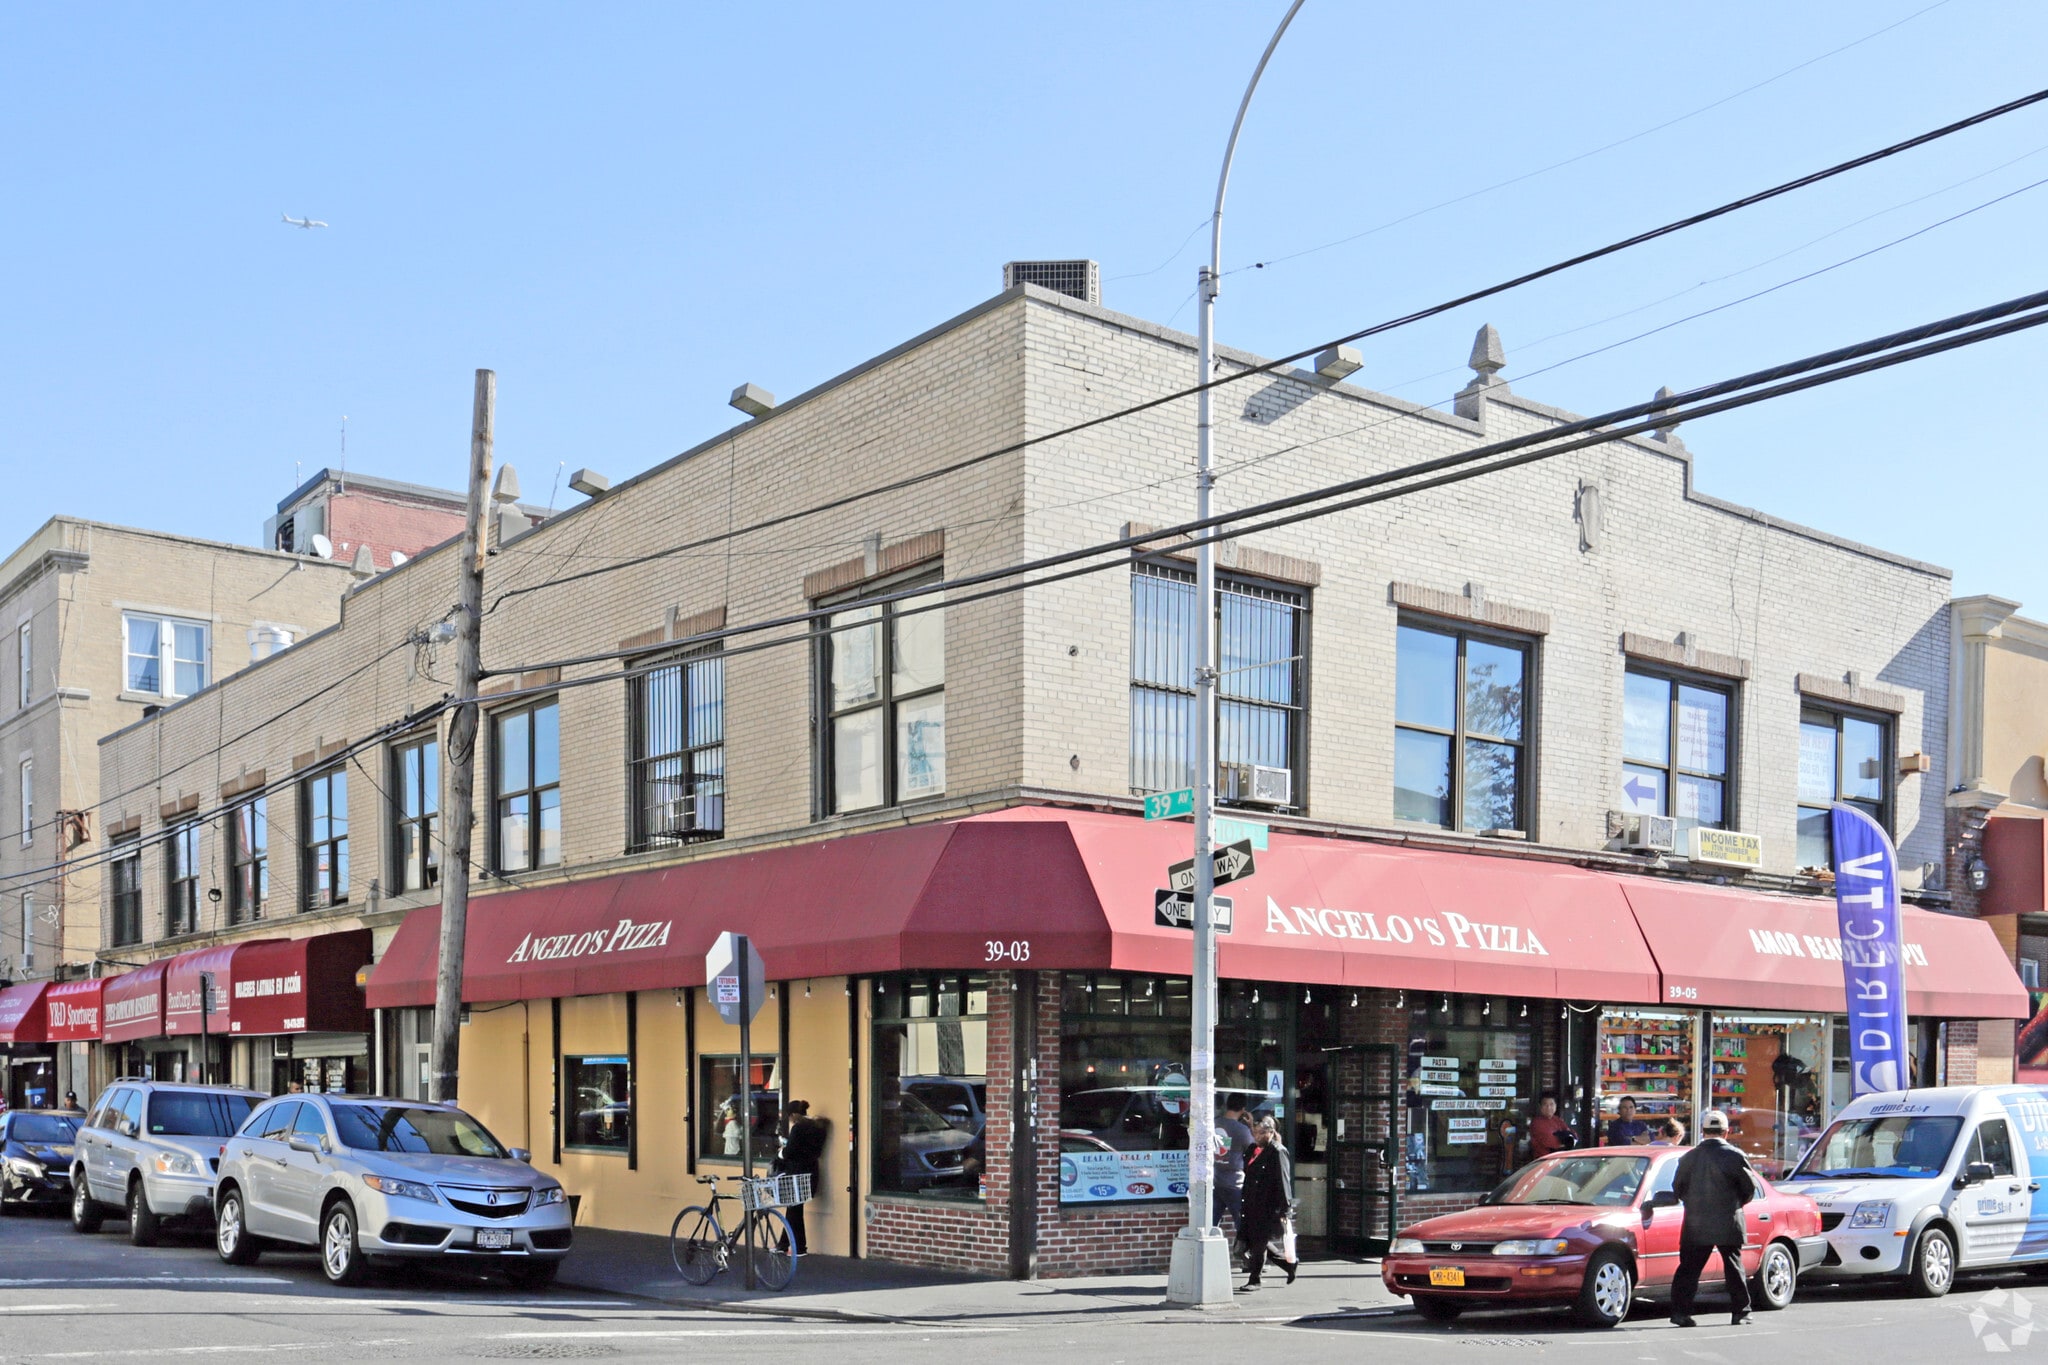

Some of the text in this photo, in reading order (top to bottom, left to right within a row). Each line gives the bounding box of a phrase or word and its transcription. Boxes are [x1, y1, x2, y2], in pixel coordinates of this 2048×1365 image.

[1151, 791, 1189, 818] 39 AV
[1700, 831, 1759, 850] INCOME TAX
[1724, 846, 1749, 855] NUMBER
[1181, 854, 1241, 886] ON WAY
[1165, 903, 1186, 918] ONE
[1265, 895, 1549, 956] ANGELO'S PIZZA
[506, 919, 673, 963] ANGELO'S PIZZA
[1749, 929, 1806, 958] AMOR
[985, 940, 1030, 962] 39-03
[276, 977, 284, 995] EN
[1670, 986, 1697, 1000] 39-05
[49, 1002, 66, 1028] Y&D
[67, 1003, 98, 1032] Sportwear
[1432, 1058, 1447, 1067] PASTA
[1491, 1060, 1504, 1069] PIZZA
[1270, 1074, 1281, 1090] A
[1427, 1072, 1436, 1080] HOT
[1488, 1087, 1506, 1096] SALADS
[1434, 1100, 1502, 1109] CATERING FOR ALL OCCASIONS
